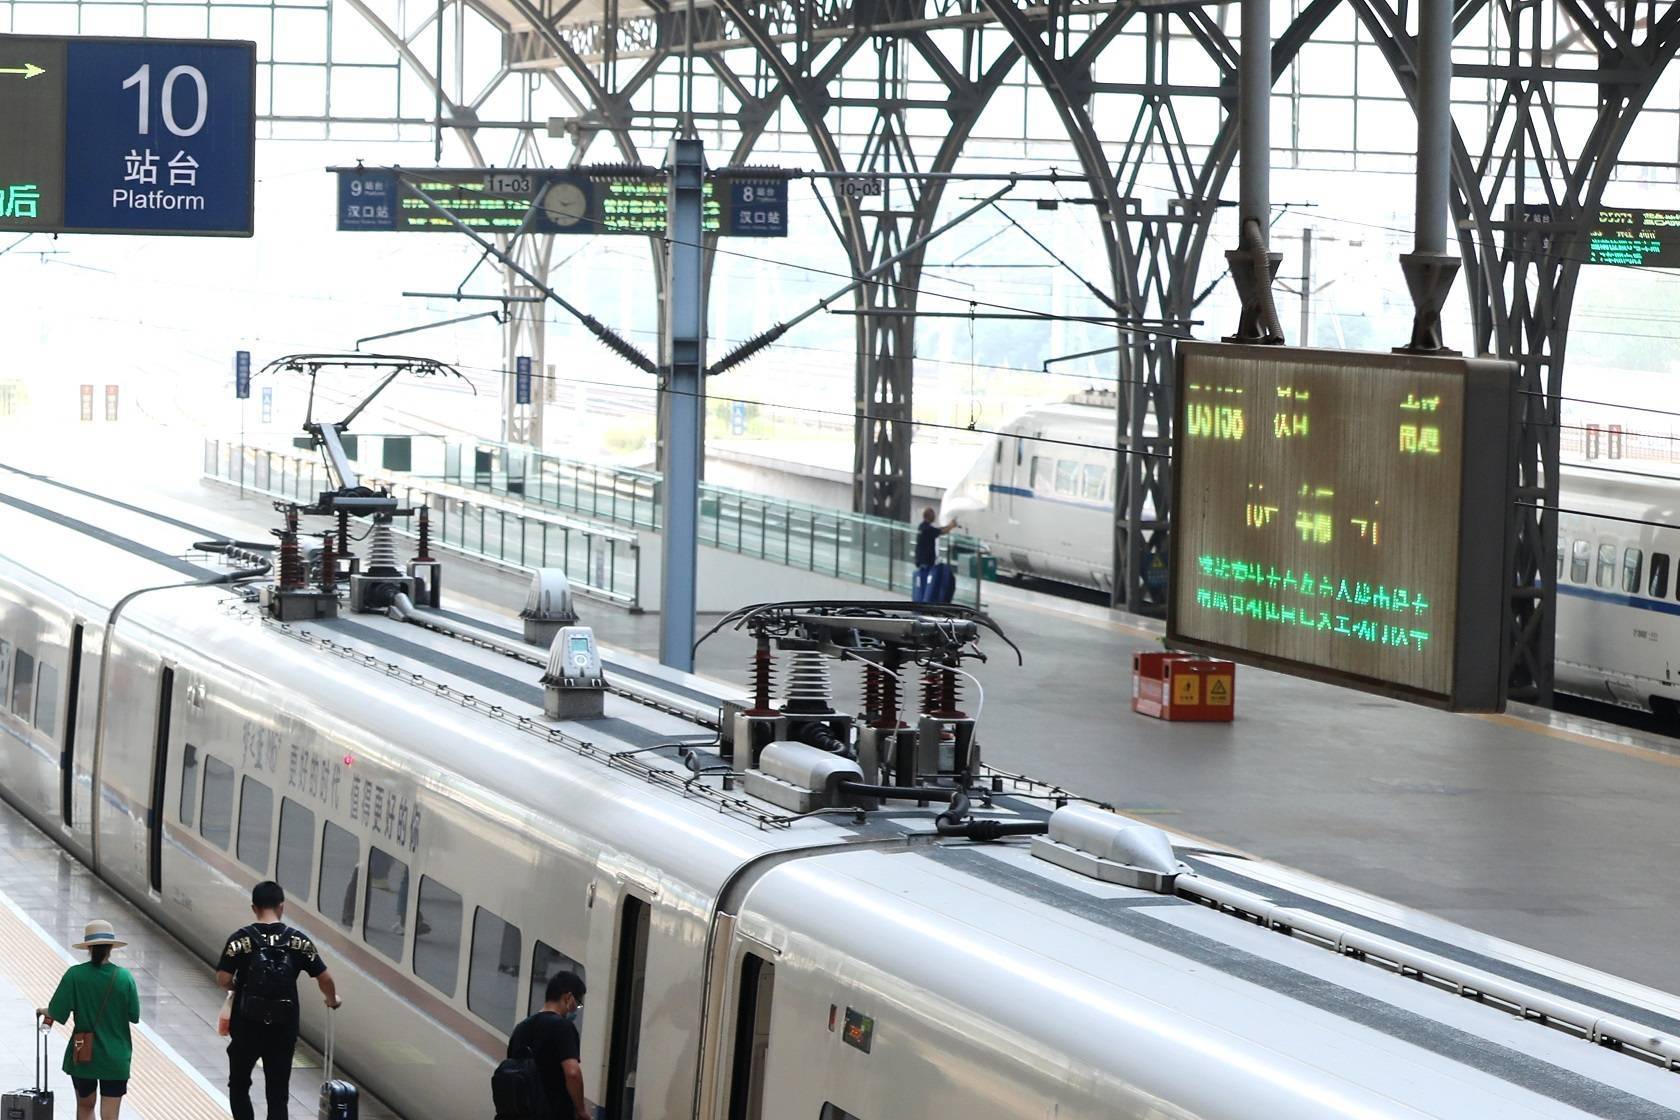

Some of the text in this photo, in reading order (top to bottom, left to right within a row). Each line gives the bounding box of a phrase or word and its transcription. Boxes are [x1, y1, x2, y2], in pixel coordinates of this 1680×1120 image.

[122, 64, 208, 137] 10
[124, 149, 200, 186] 站台
[351, 181, 362, 196] 9
[488, 178, 529, 192] 11-03
[113, 189, 205, 211] Platform
[743, 187, 753, 202] 8
[348, 206, 389, 218] 汉口站
[740, 211, 780, 224] 汉口站
